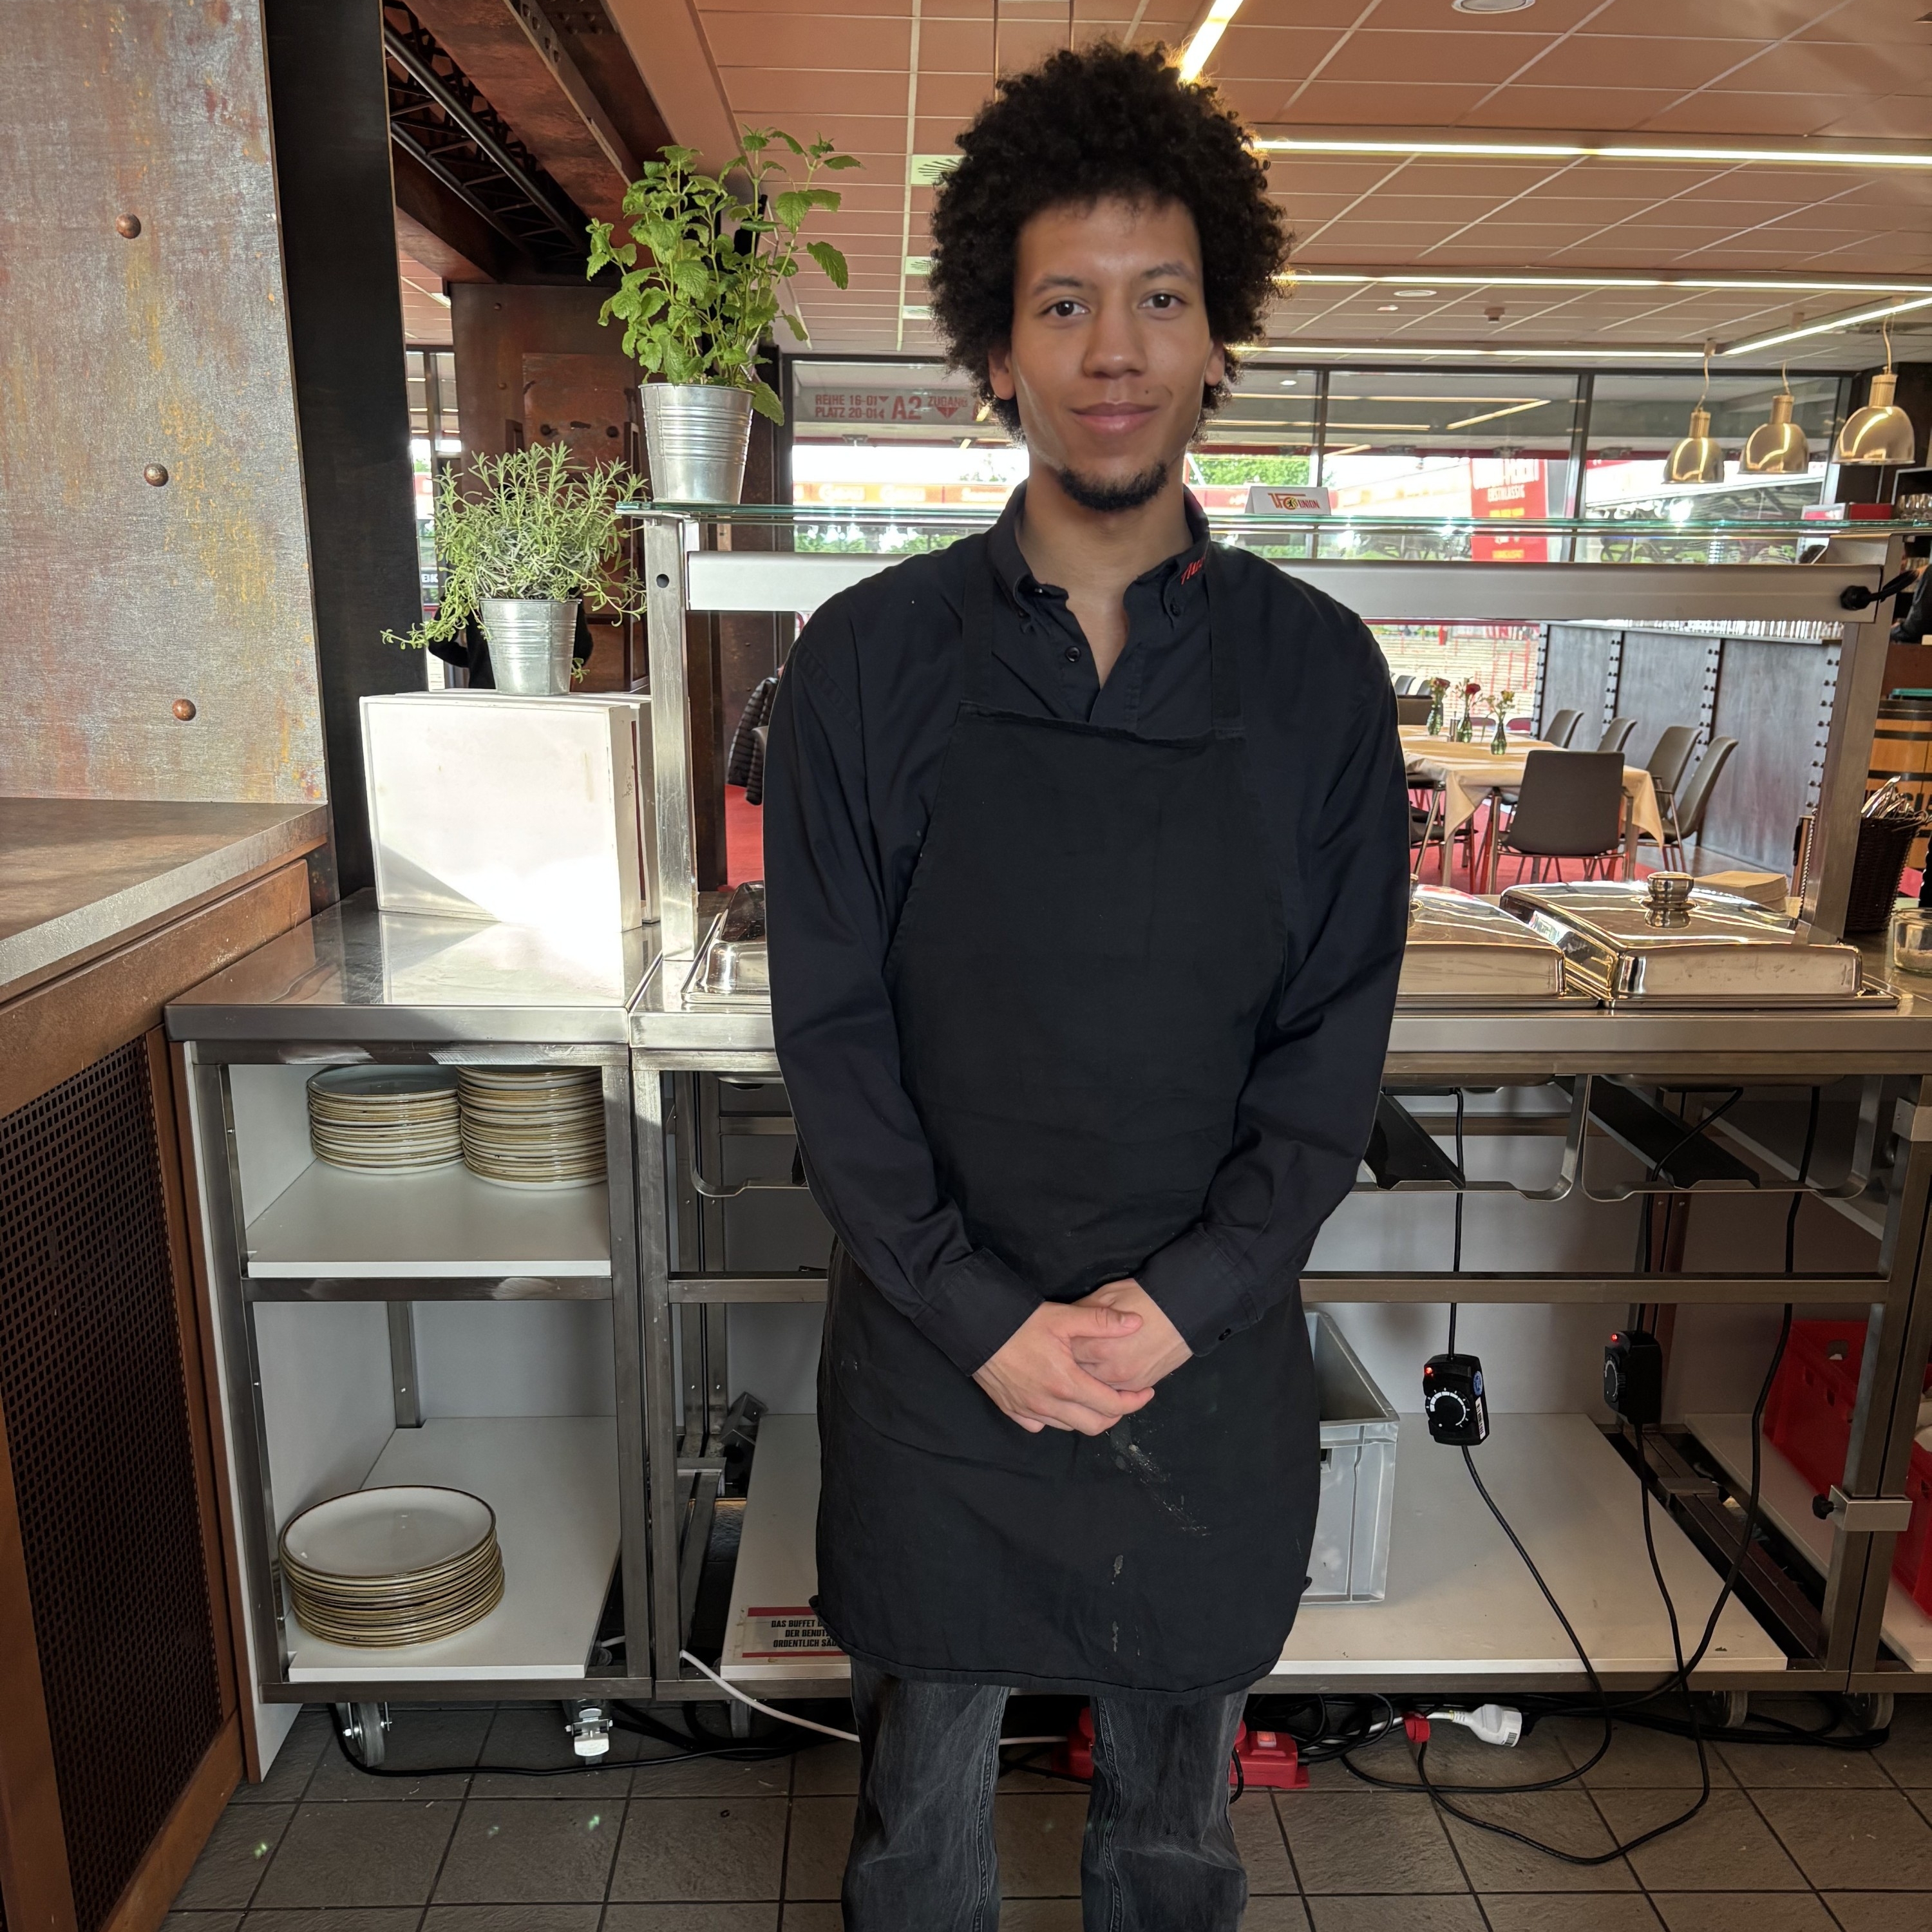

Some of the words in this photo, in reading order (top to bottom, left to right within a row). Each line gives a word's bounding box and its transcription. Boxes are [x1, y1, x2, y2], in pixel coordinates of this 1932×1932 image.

[815, 394, 845, 406] REIHE
[815, 406, 846, 418] PLATZ
[848, 407, 877, 419] 20-01
[891, 395, 922, 421] A2
[1297, 498, 1320, 509] UNION
[802, 1629, 829, 1637] BENUT
[773, 1639, 819, 1647] ORDENTLICH
[821, 1638, 837, 1647] SÄU
